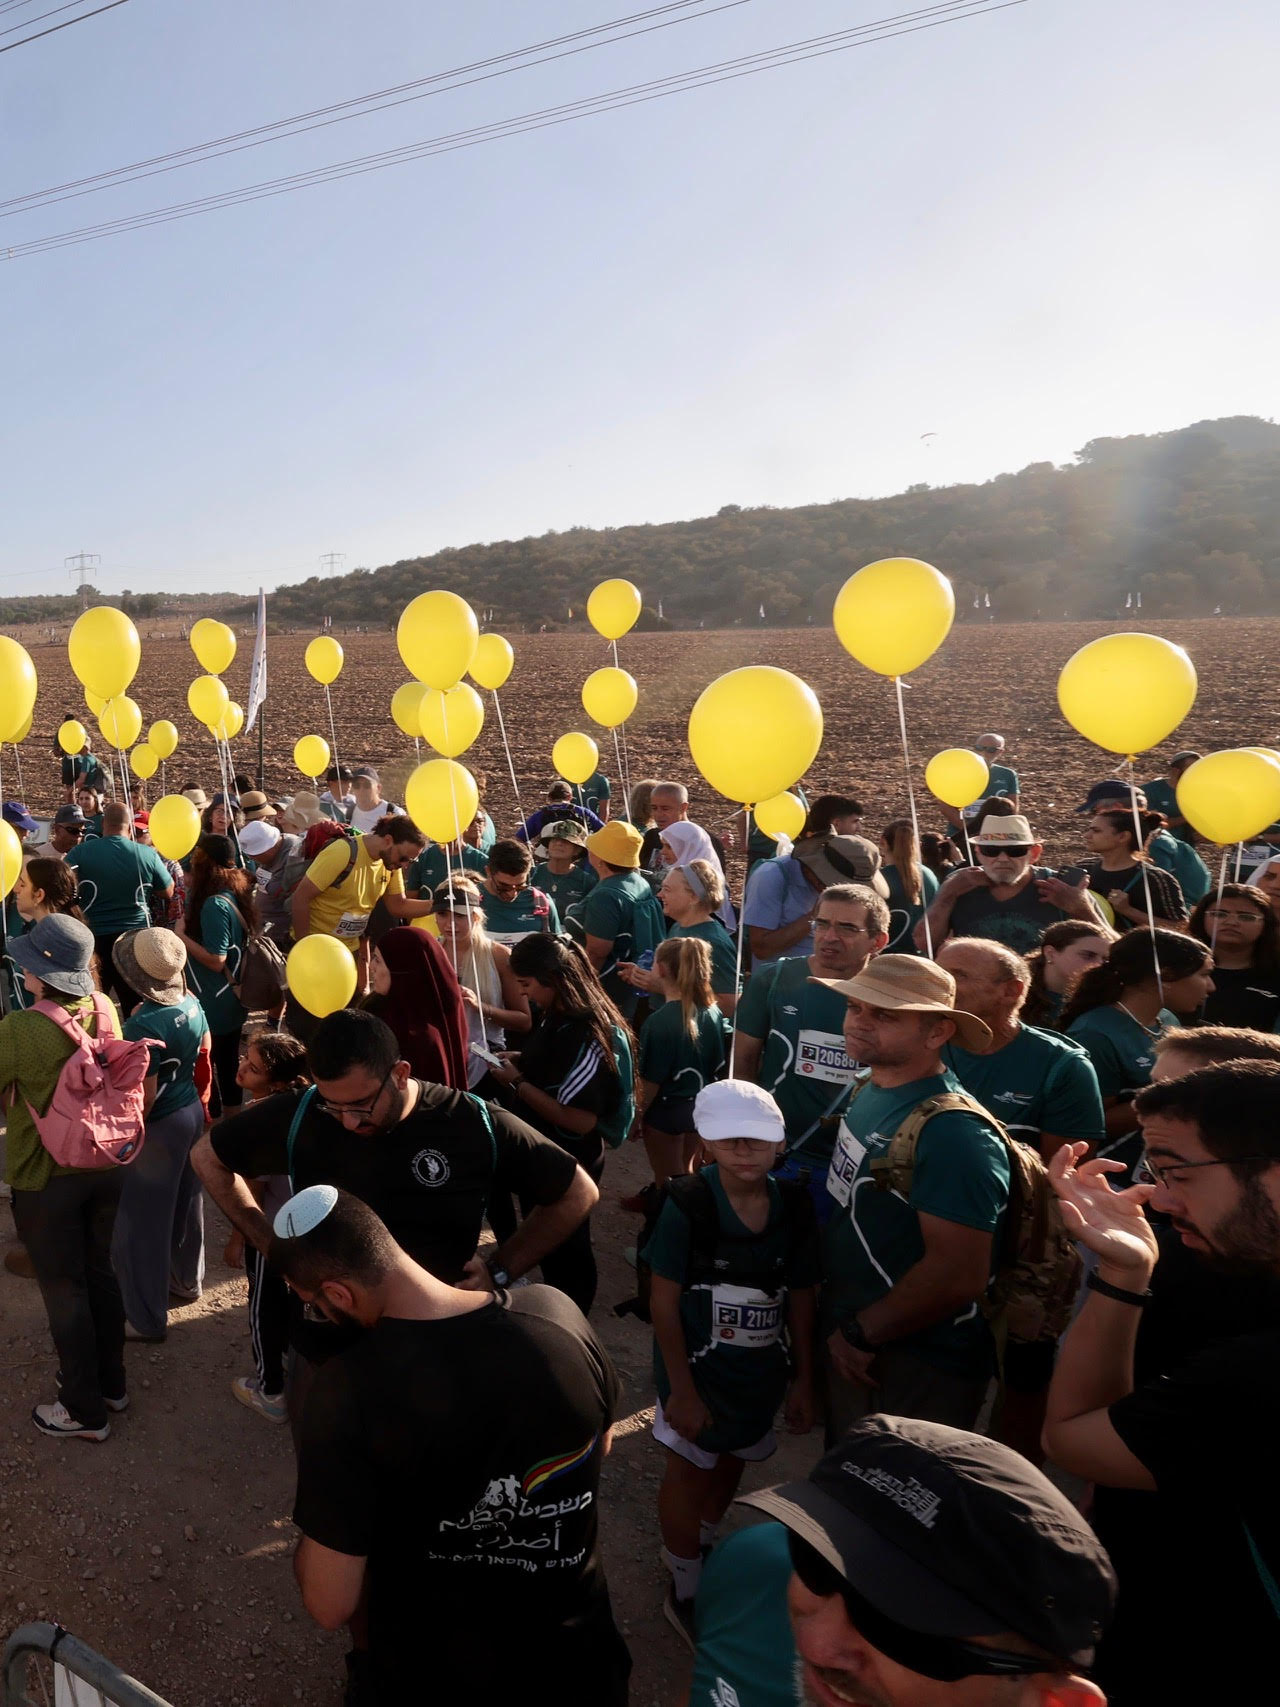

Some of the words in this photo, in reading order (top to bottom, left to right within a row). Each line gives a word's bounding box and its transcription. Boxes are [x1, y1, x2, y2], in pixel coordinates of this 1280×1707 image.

[841, 1461, 924, 1520] COLLECTION
[868, 1468, 931, 1512] NATURE
[906, 1477, 940, 1503] THE
